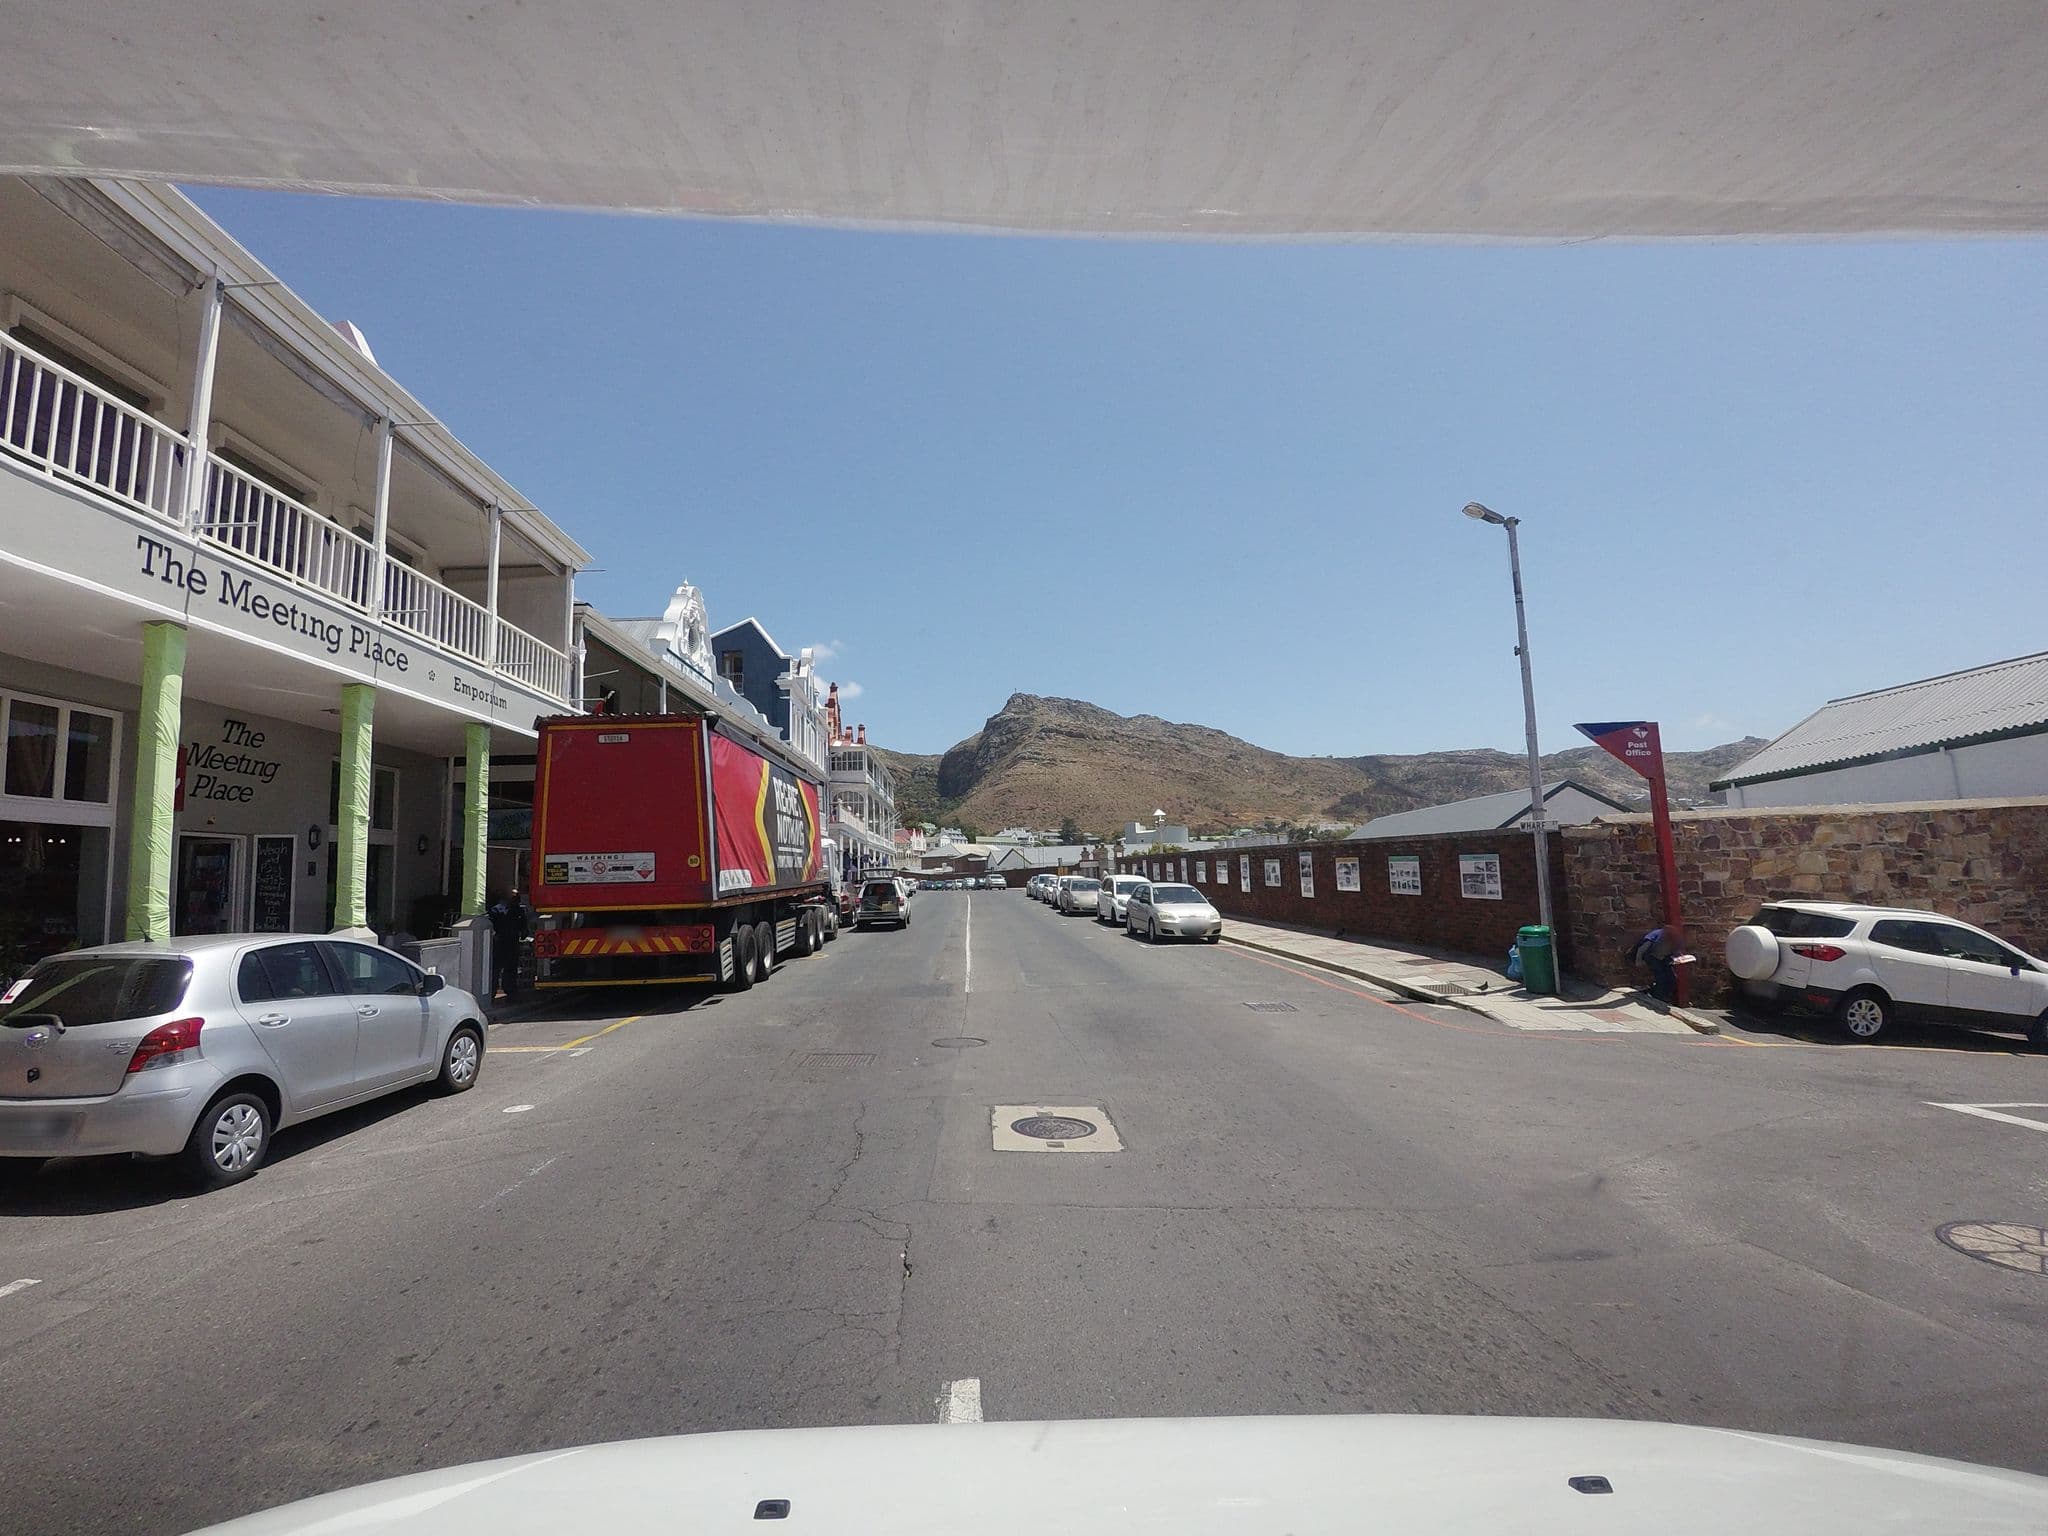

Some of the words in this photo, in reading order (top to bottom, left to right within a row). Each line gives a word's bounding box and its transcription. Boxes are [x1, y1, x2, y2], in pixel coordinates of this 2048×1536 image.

[137, 535, 207, 595] The
[218, 570, 343, 654] Meeting
[349, 624, 409, 672] Place
[453, 675, 508, 710] Emporium
[223, 719, 266, 748] The
[1628, 741, 1648, 749] Post
[186, 742, 281, 783] Meeting
[188, 774, 254, 802] Place
[1520, 821, 1546, 830] WHARF
